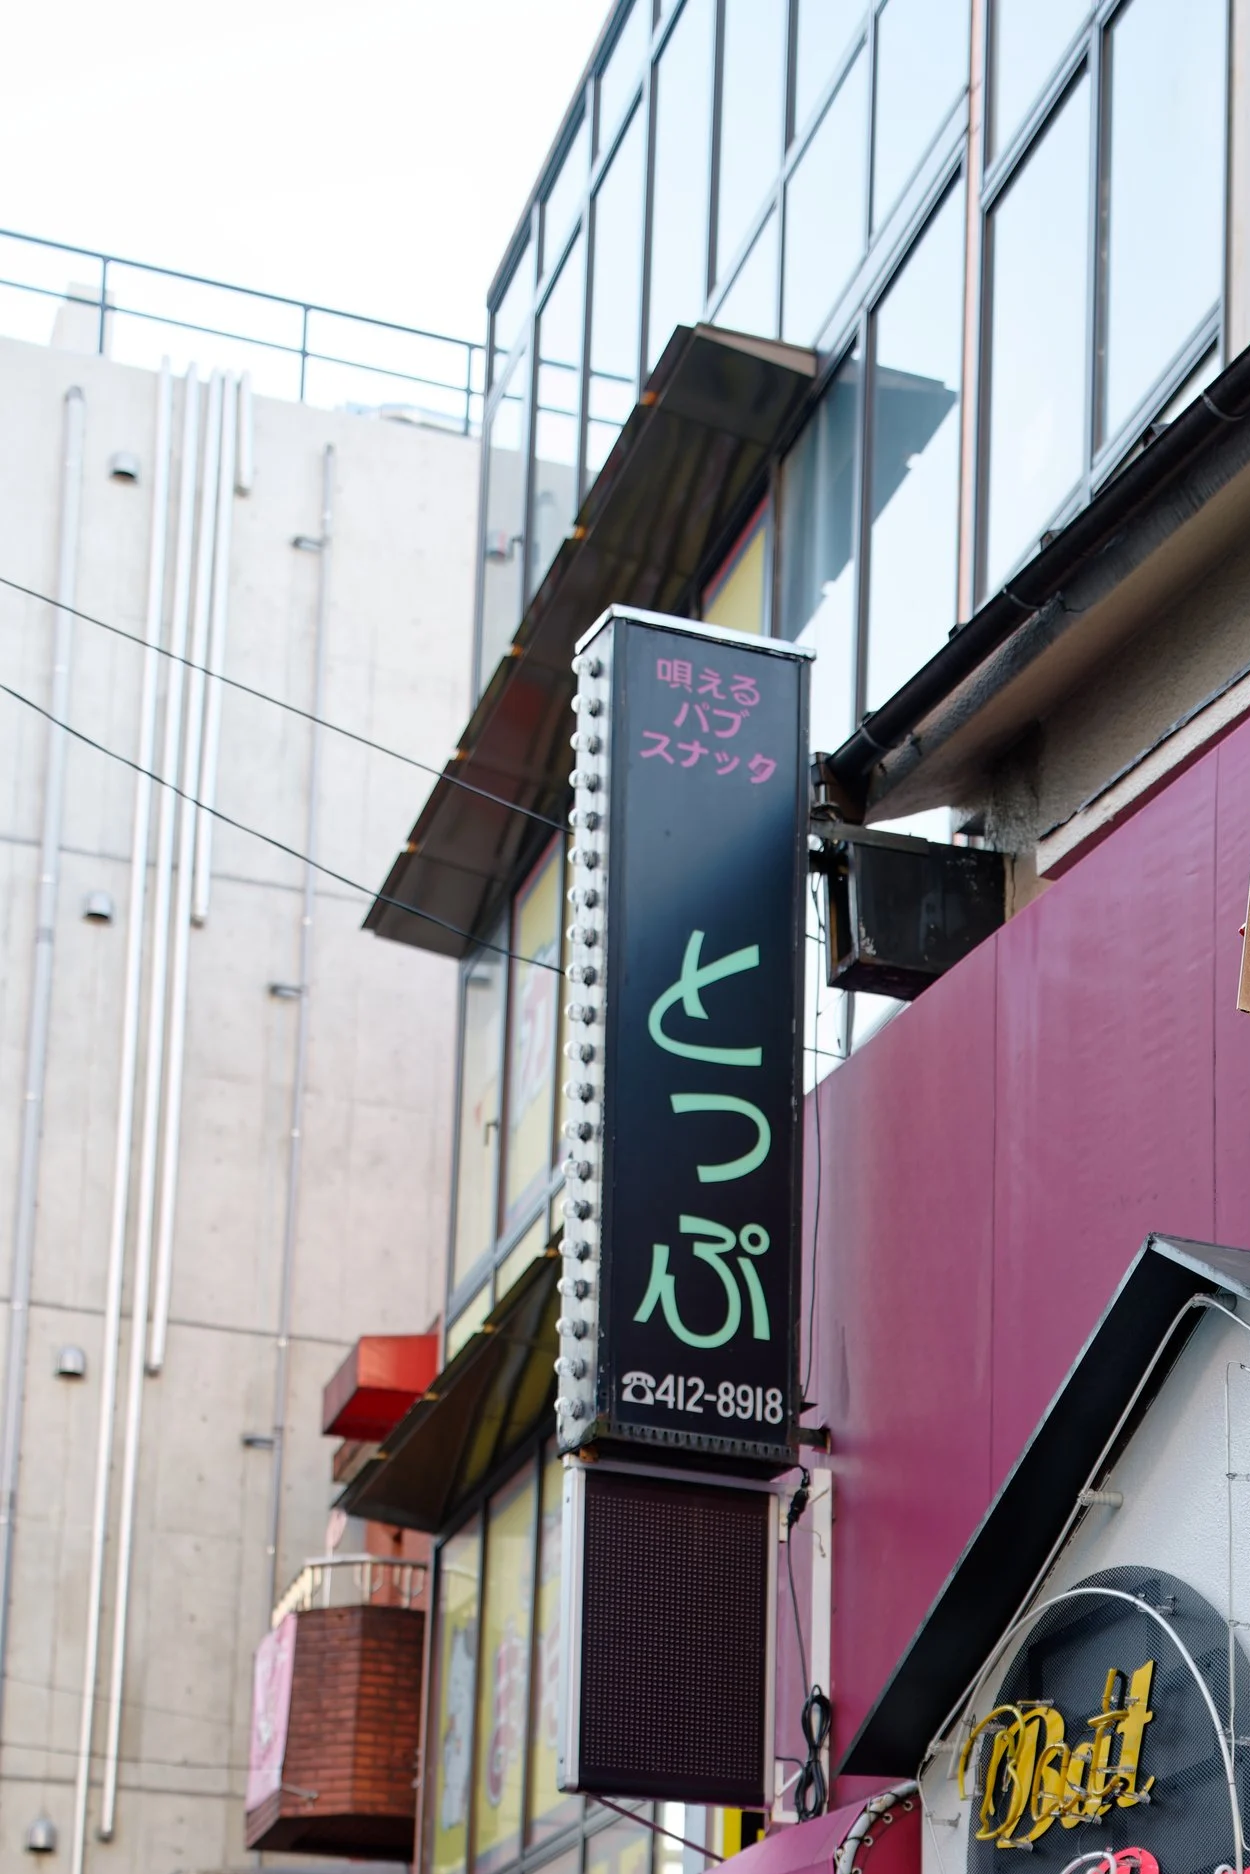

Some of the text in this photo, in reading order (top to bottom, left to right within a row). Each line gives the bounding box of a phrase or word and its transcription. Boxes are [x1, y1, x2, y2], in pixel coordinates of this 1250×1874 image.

[656, 657, 761, 707] 唄える
[672, 701, 751, 739] パブ
[633, 928, 772, 1349] とっぷ
[655, 1373, 784, 1425] 412-8918
